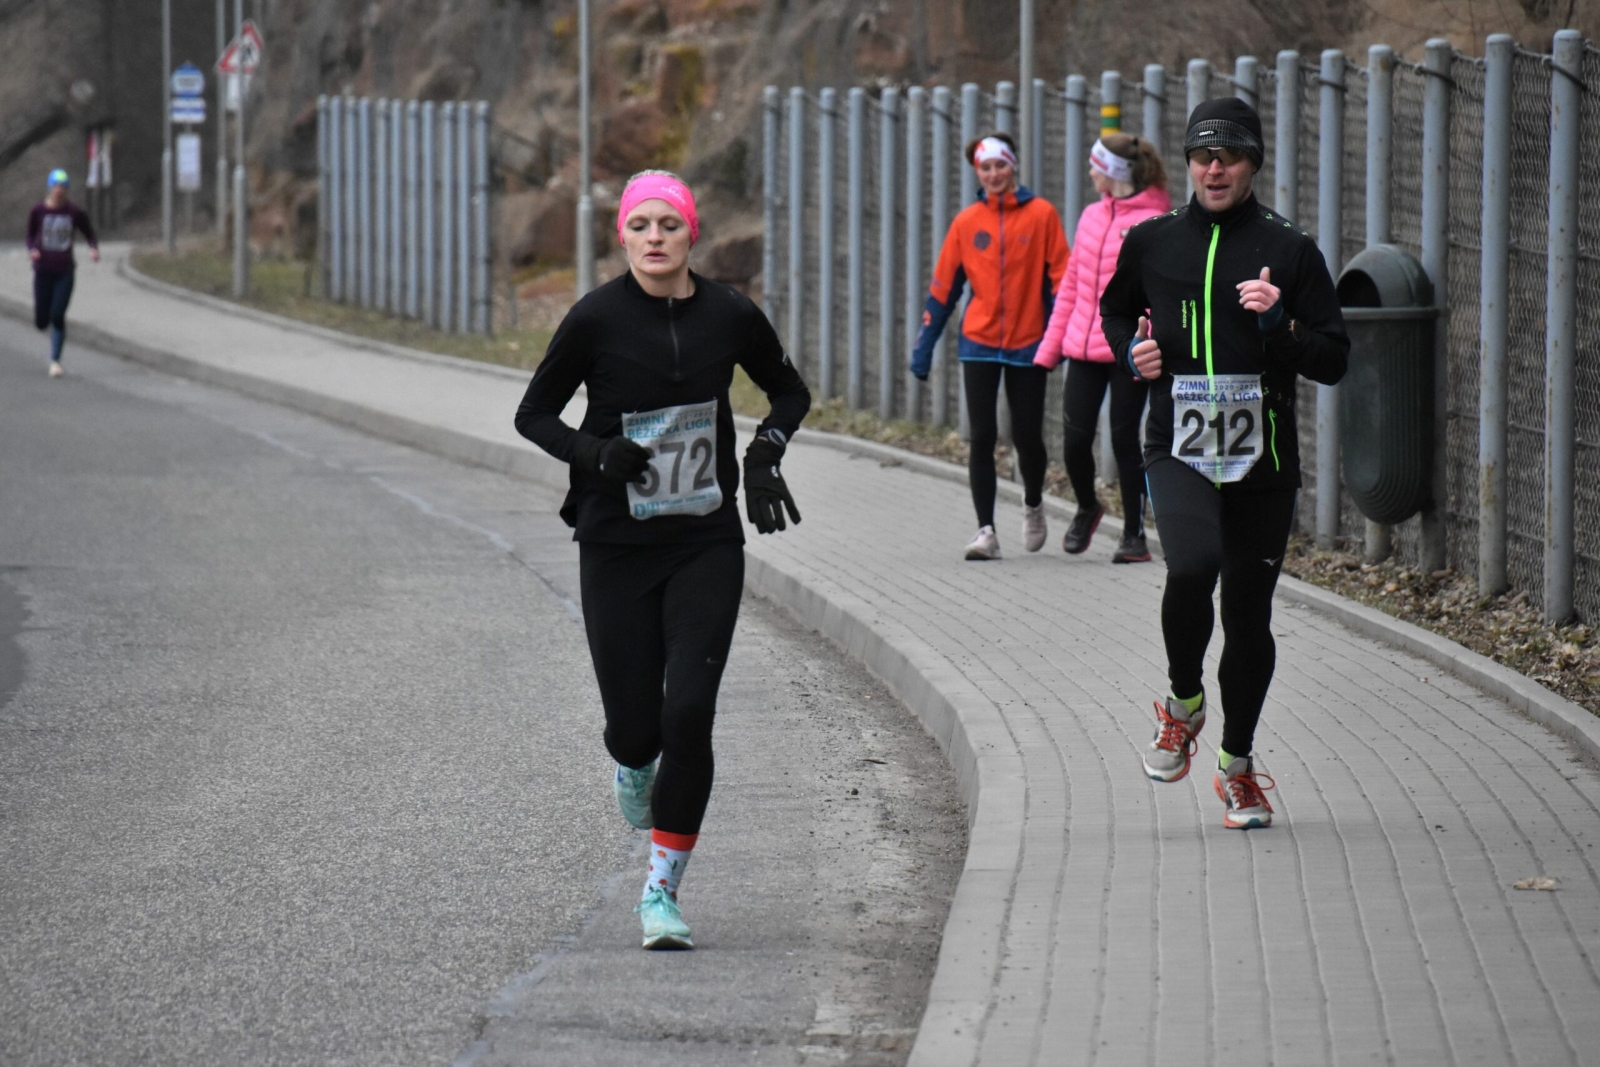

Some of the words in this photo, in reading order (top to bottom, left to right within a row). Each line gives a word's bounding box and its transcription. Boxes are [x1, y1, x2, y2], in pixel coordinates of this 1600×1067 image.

[1177, 379, 1210, 391] ZIMNÍ
[1176, 391, 1227, 403] BĚŽECKÁ
[1232, 392, 1260, 402] LIGA
[627, 411, 665, 427] ZIMNÍ
[627, 423, 680, 439] BĚŽECKÁ
[685, 419, 712, 430] LIGA
[1178, 408, 1255, 457] 212
